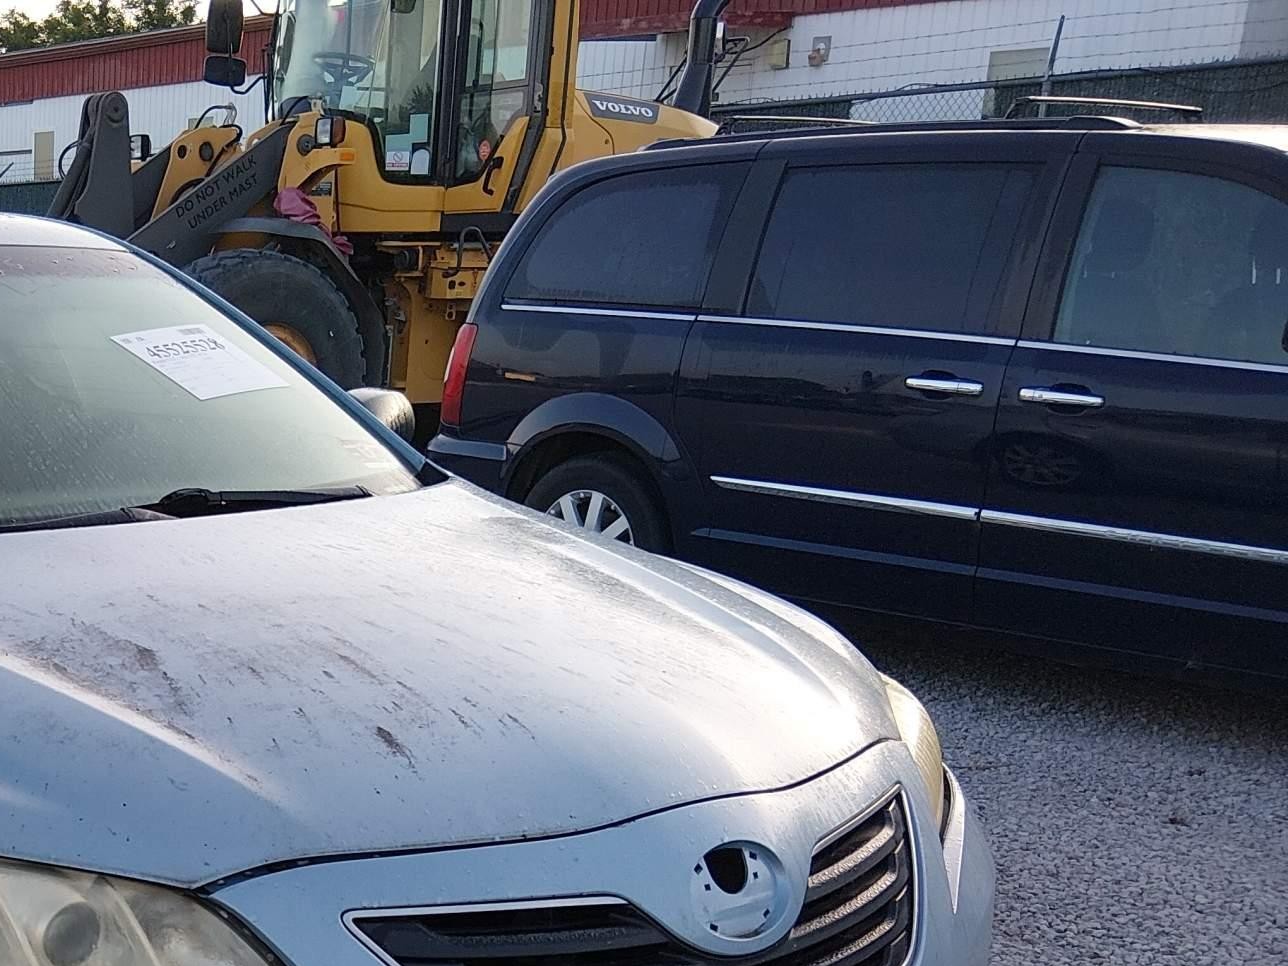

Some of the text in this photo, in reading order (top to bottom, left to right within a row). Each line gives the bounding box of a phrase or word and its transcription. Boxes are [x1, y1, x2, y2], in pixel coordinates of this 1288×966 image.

[592, 100, 653, 118] VOLVO
[175, 154, 257, 218] DO NOT WALK
[188, 174, 258, 229] UNDER MAST
[145, 337, 226, 360] 45525528
